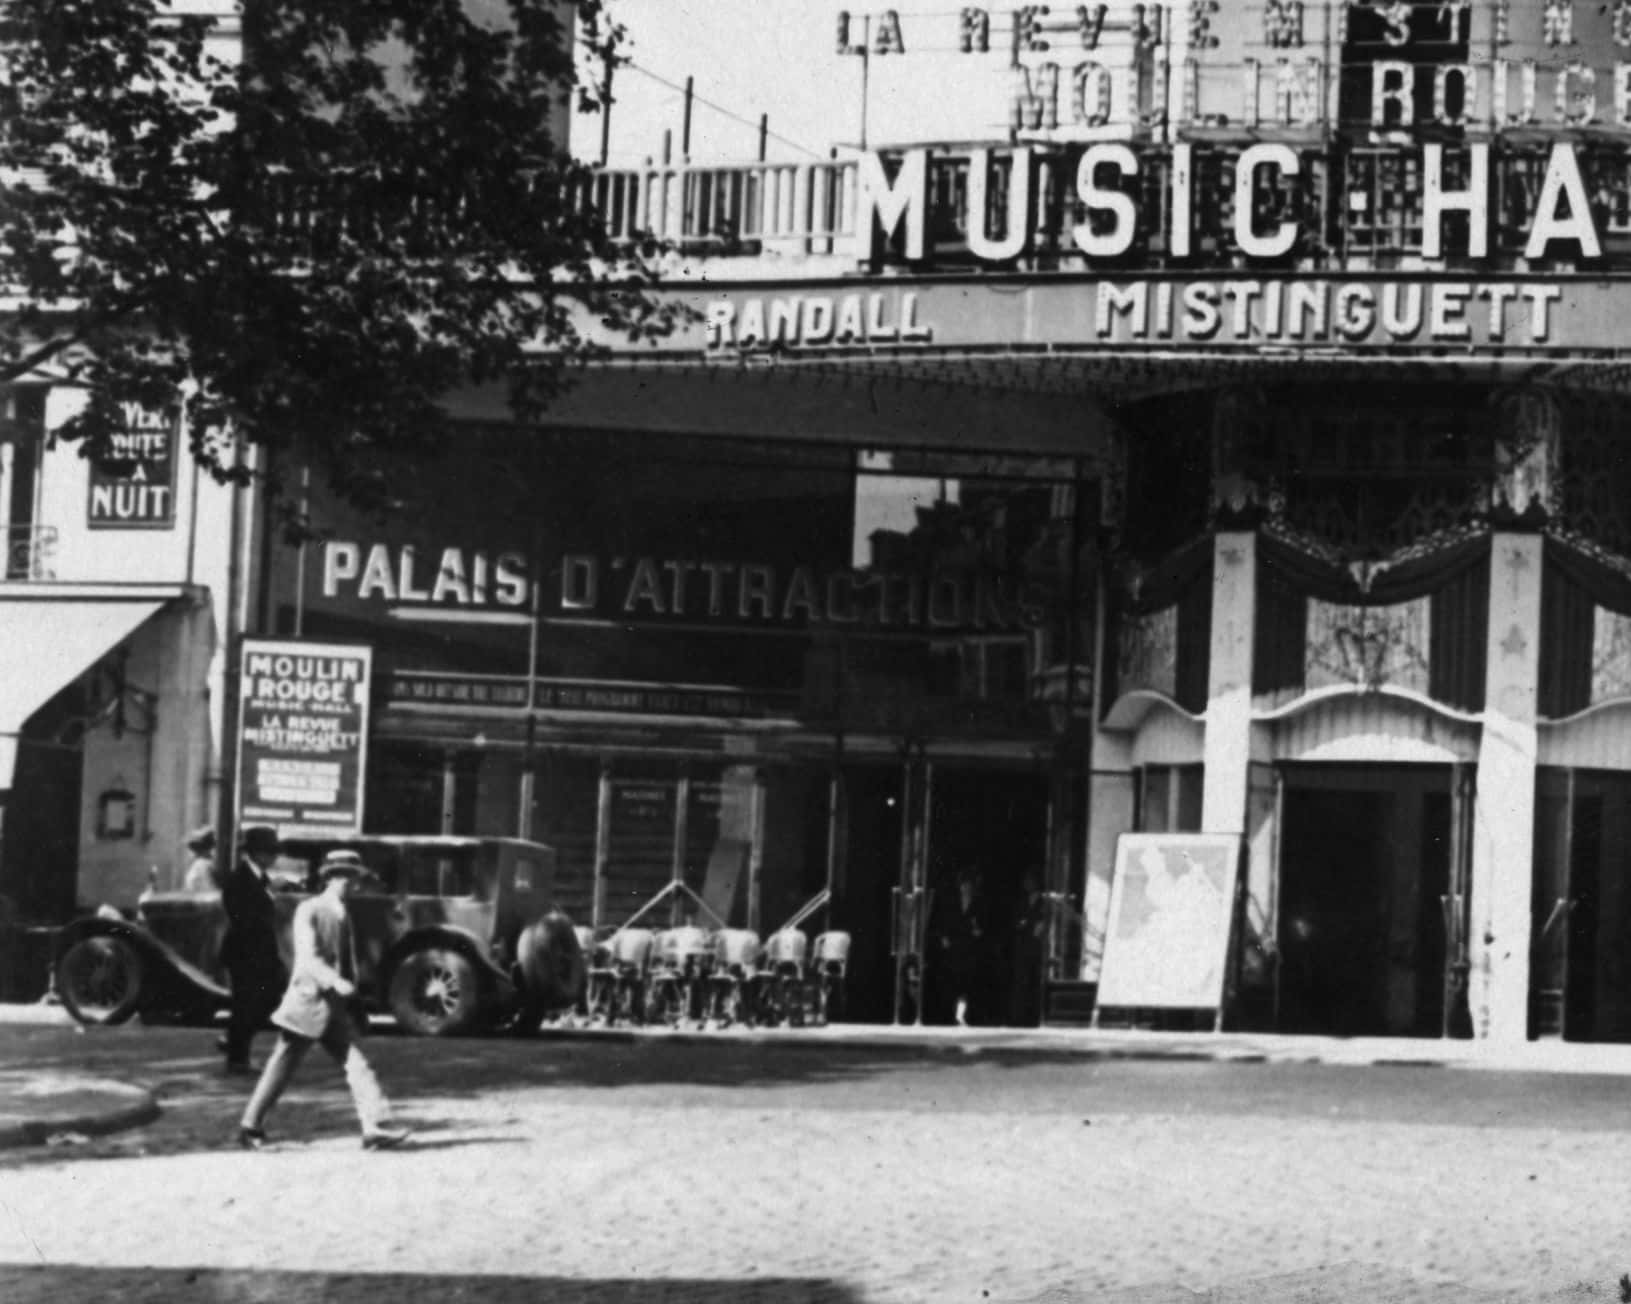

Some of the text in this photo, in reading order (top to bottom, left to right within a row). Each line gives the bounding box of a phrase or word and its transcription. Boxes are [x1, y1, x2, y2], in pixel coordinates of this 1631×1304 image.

[837, 10, 904, 54] LA
[959, 1, 1220, 53] REVUE
[1010, 57, 1322, 130] MOULIN
[705, 294, 933, 350] RANDALL
[1097, 281, 1562, 342] MISTINGUETT
[92, 484, 170, 517] NUIT
[323, 541, 529, 606] PALAIS
[250, 655, 359, 680] MOULIN
[257, 677, 347, 702] ROUGE
[262, 714, 282, 729] LA
